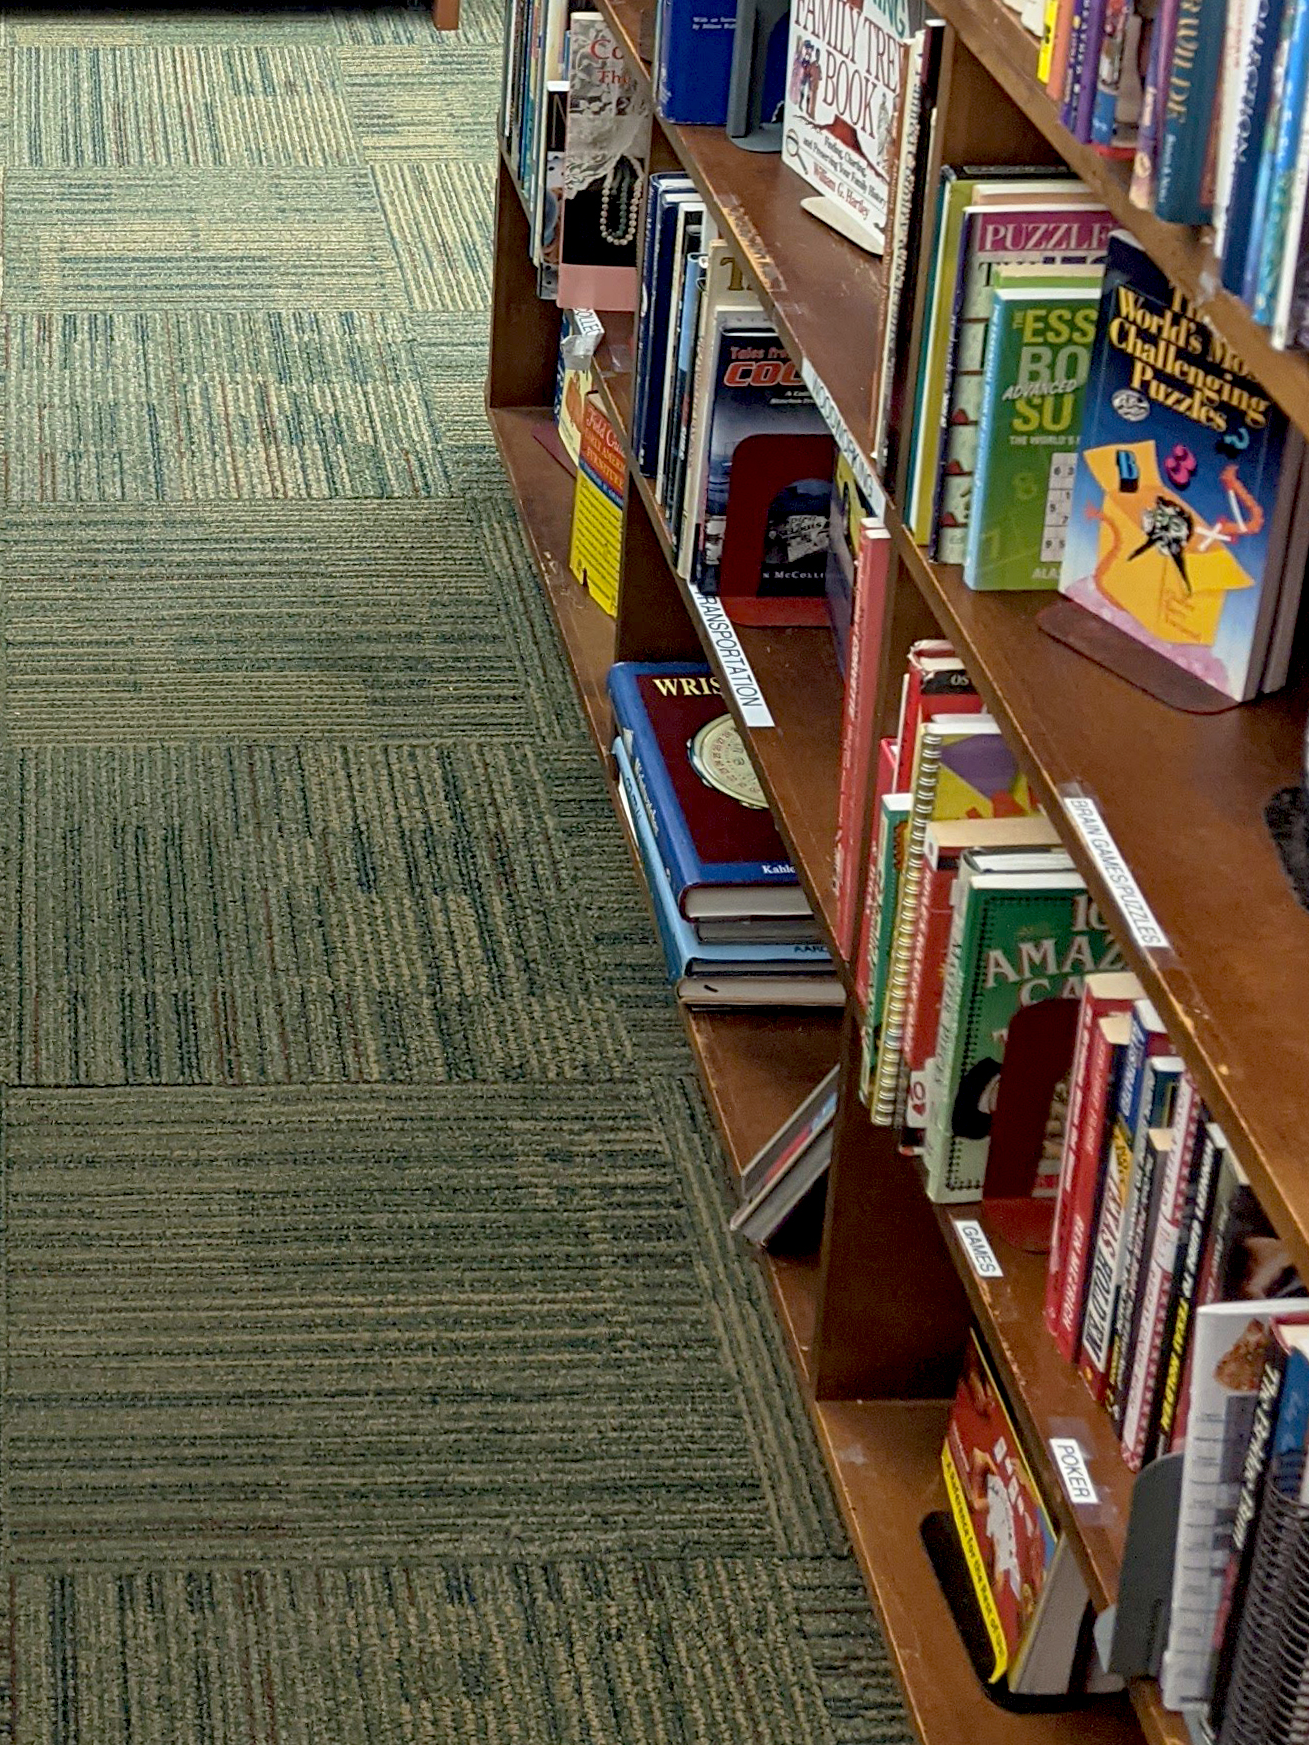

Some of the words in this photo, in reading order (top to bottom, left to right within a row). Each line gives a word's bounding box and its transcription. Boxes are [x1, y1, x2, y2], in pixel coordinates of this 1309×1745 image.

[1171, 17, 1201, 123] WILDE
[823, 49, 879, 142] BOOK
[984, 222, 1113, 252] PUZZLE
[1024, 309, 1097, 344] ESS
[1116, 290, 1202, 352] World's
[1002, 379, 1078, 402] ADVANCED
[1109, 316, 1270, 429] Challenging
[1012, 396, 1071, 431] SU
[1130, 367, 1228, 433] Puzzles
[1070, 800, 1100, 836] BRAIN
[962, 1226, 996, 1273] GAMES
[1057, 1444, 1090, 1498] POKER
